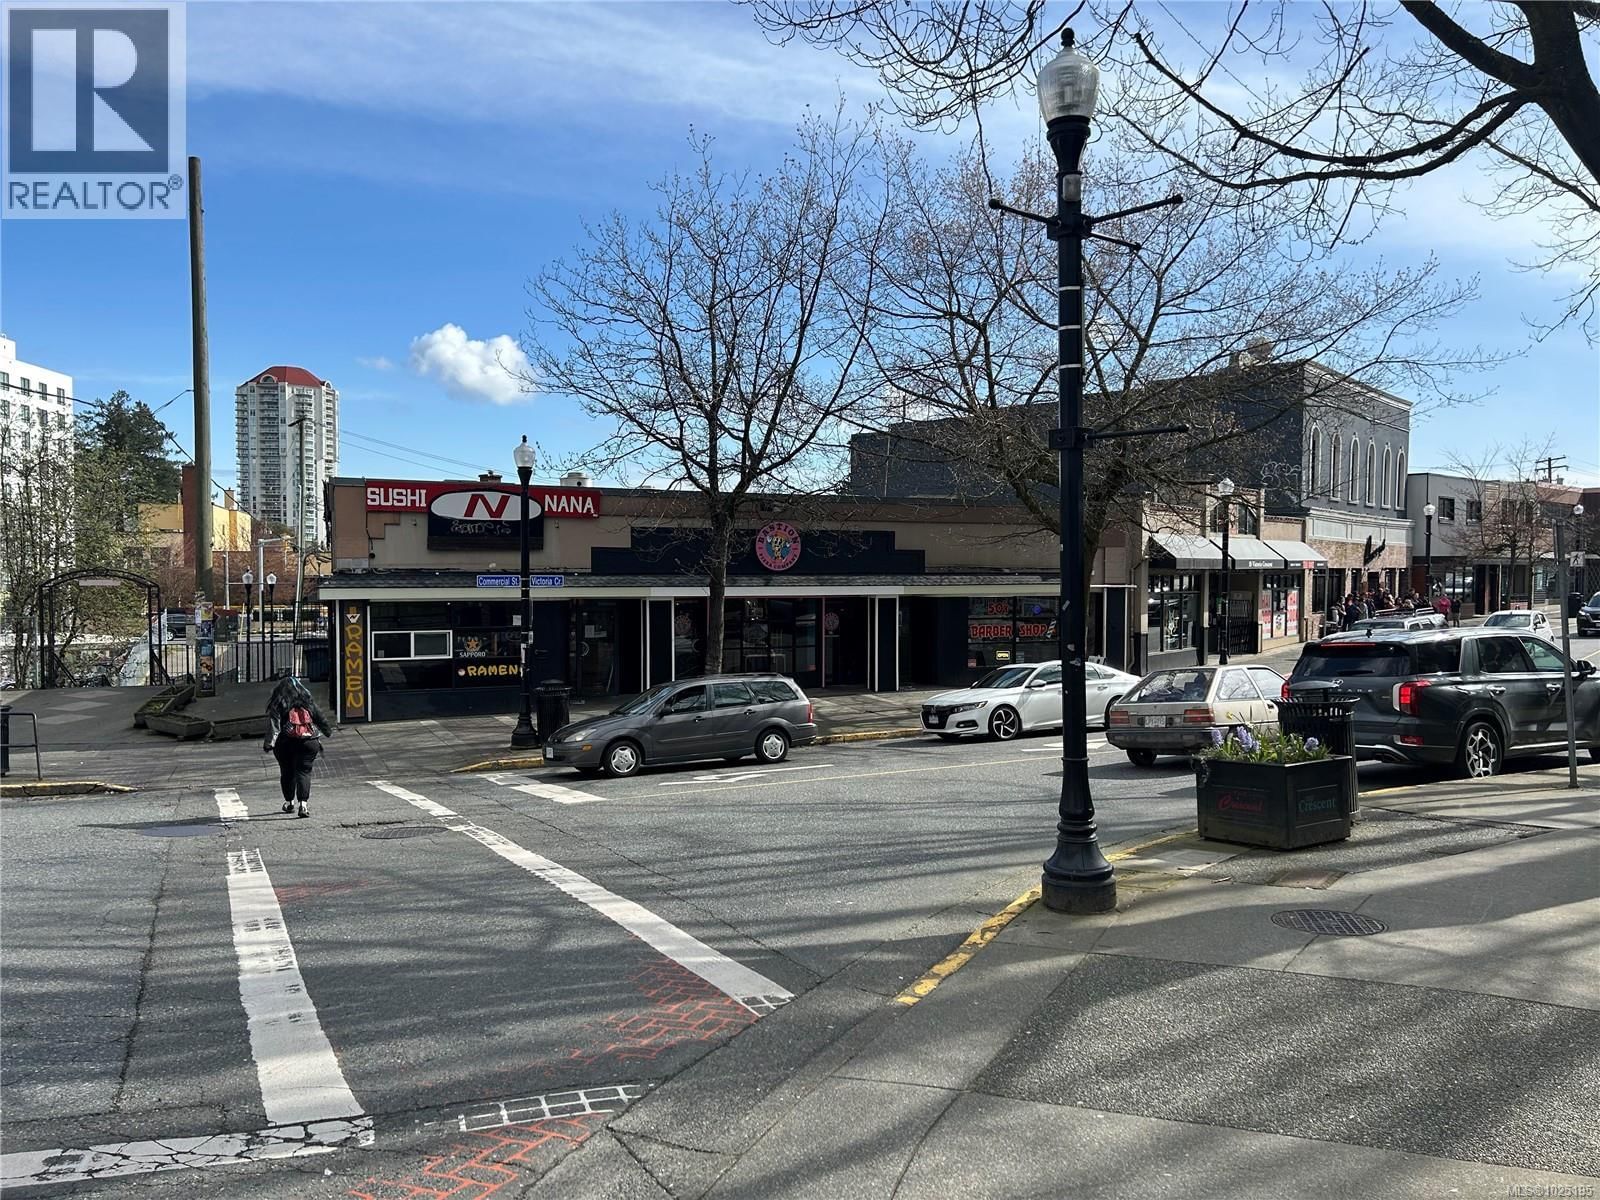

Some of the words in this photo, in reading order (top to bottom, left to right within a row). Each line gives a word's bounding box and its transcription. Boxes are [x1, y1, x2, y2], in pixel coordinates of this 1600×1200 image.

[366, 487, 427, 507] SUSHI
[463, 493, 510, 519] N
[544, 494, 594, 514] NANA
[758, 523, 800, 544] BASTION
[478, 577, 510, 586] Commercial
[531, 577, 553, 586] Victoria
[970, 624, 1014, 639] BARBER
[1018, 623, 1047, 637] SHOP
[345, 624, 364, 707] RAMEN
[466, 664, 519, 677] RAMEN
[1298, 798, 1336, 812] Crescent
